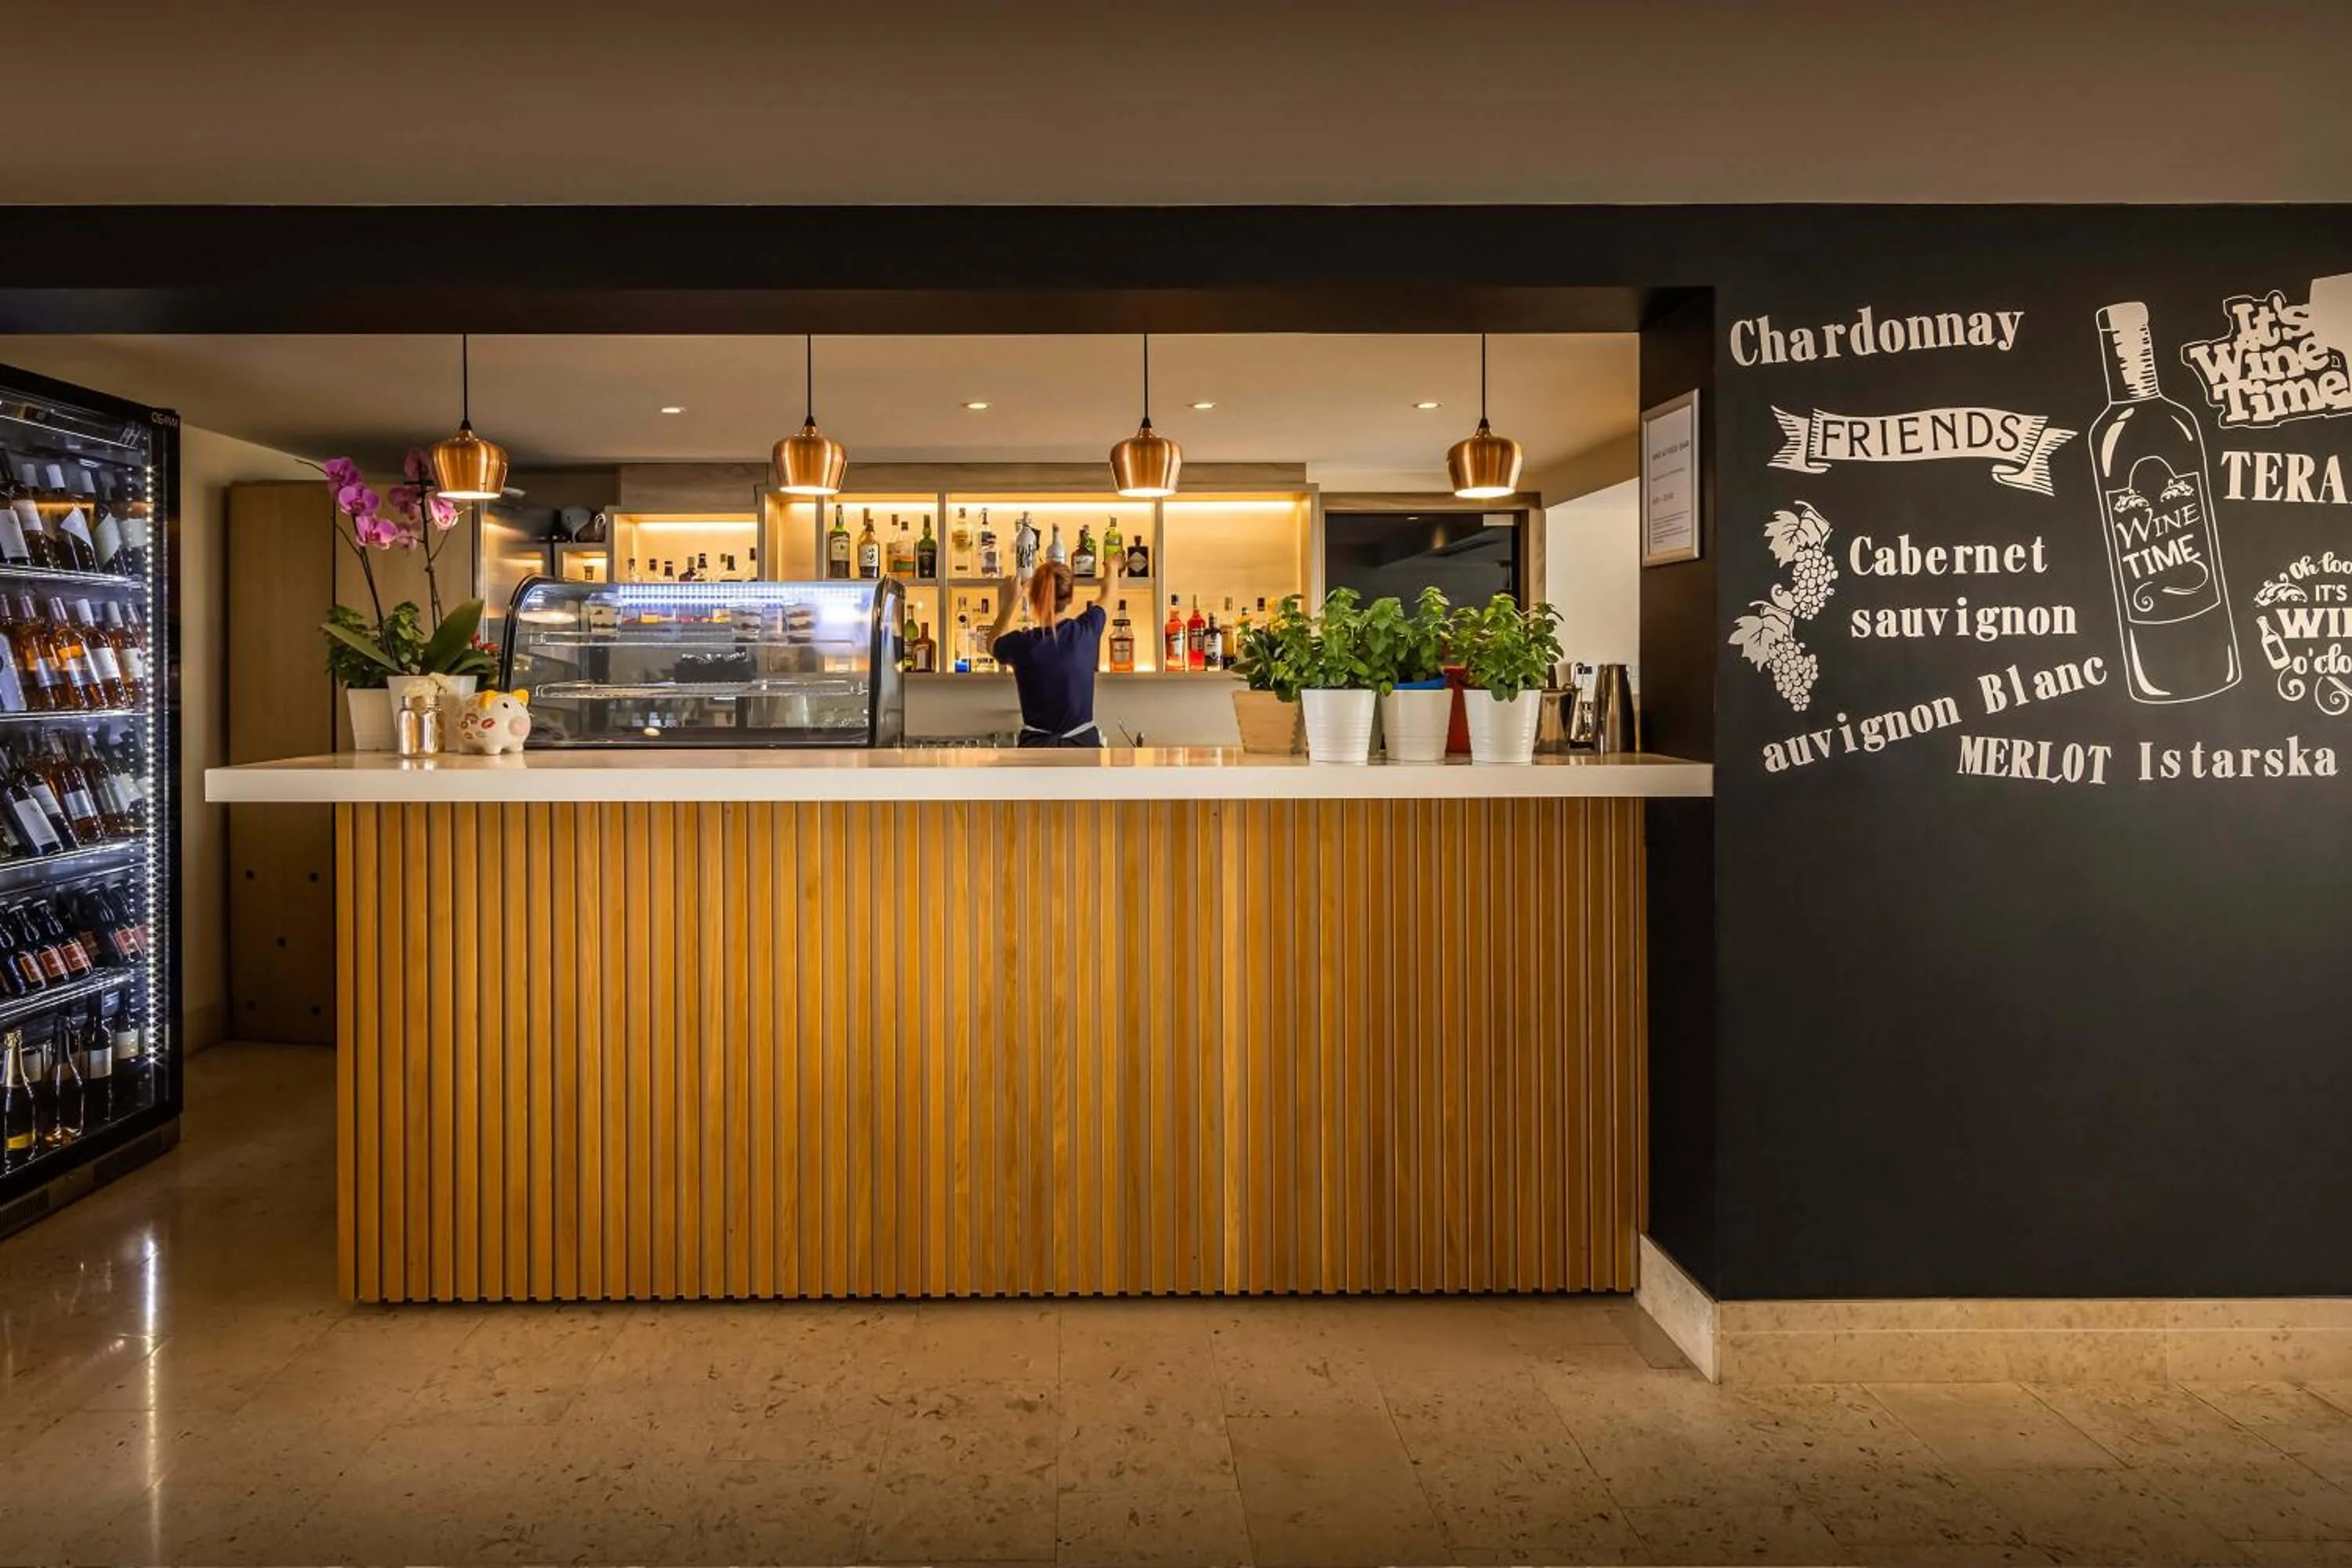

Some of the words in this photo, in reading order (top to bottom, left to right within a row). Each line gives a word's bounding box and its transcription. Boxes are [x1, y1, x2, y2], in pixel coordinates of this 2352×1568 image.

[1730, 305, 2025, 366] Chardonnay
[2232, 295, 2312, 351] It's
[2189, 337, 2329, 385] Wine
[2213, 370, 2352, 422] Time
[1820, 412, 2021, 458] FRIENDS
[2220, 451, 2352, 503] TERA
[1849, 533, 2048, 576] Cabernet
[2122, 533, 2201, 579] TIME
[2289, 555, 2320, 579] Oh
[2315, 584, 2347, 602] IT'S
[1850, 597, 2078, 642] sauvignon
[1762, 695, 1962, 774] auvignon
[1977, 655, 2107, 714] Blanc
[1957, 735, 2112, 785] MERLOT
[2138, 735, 2339, 781] Istarska
